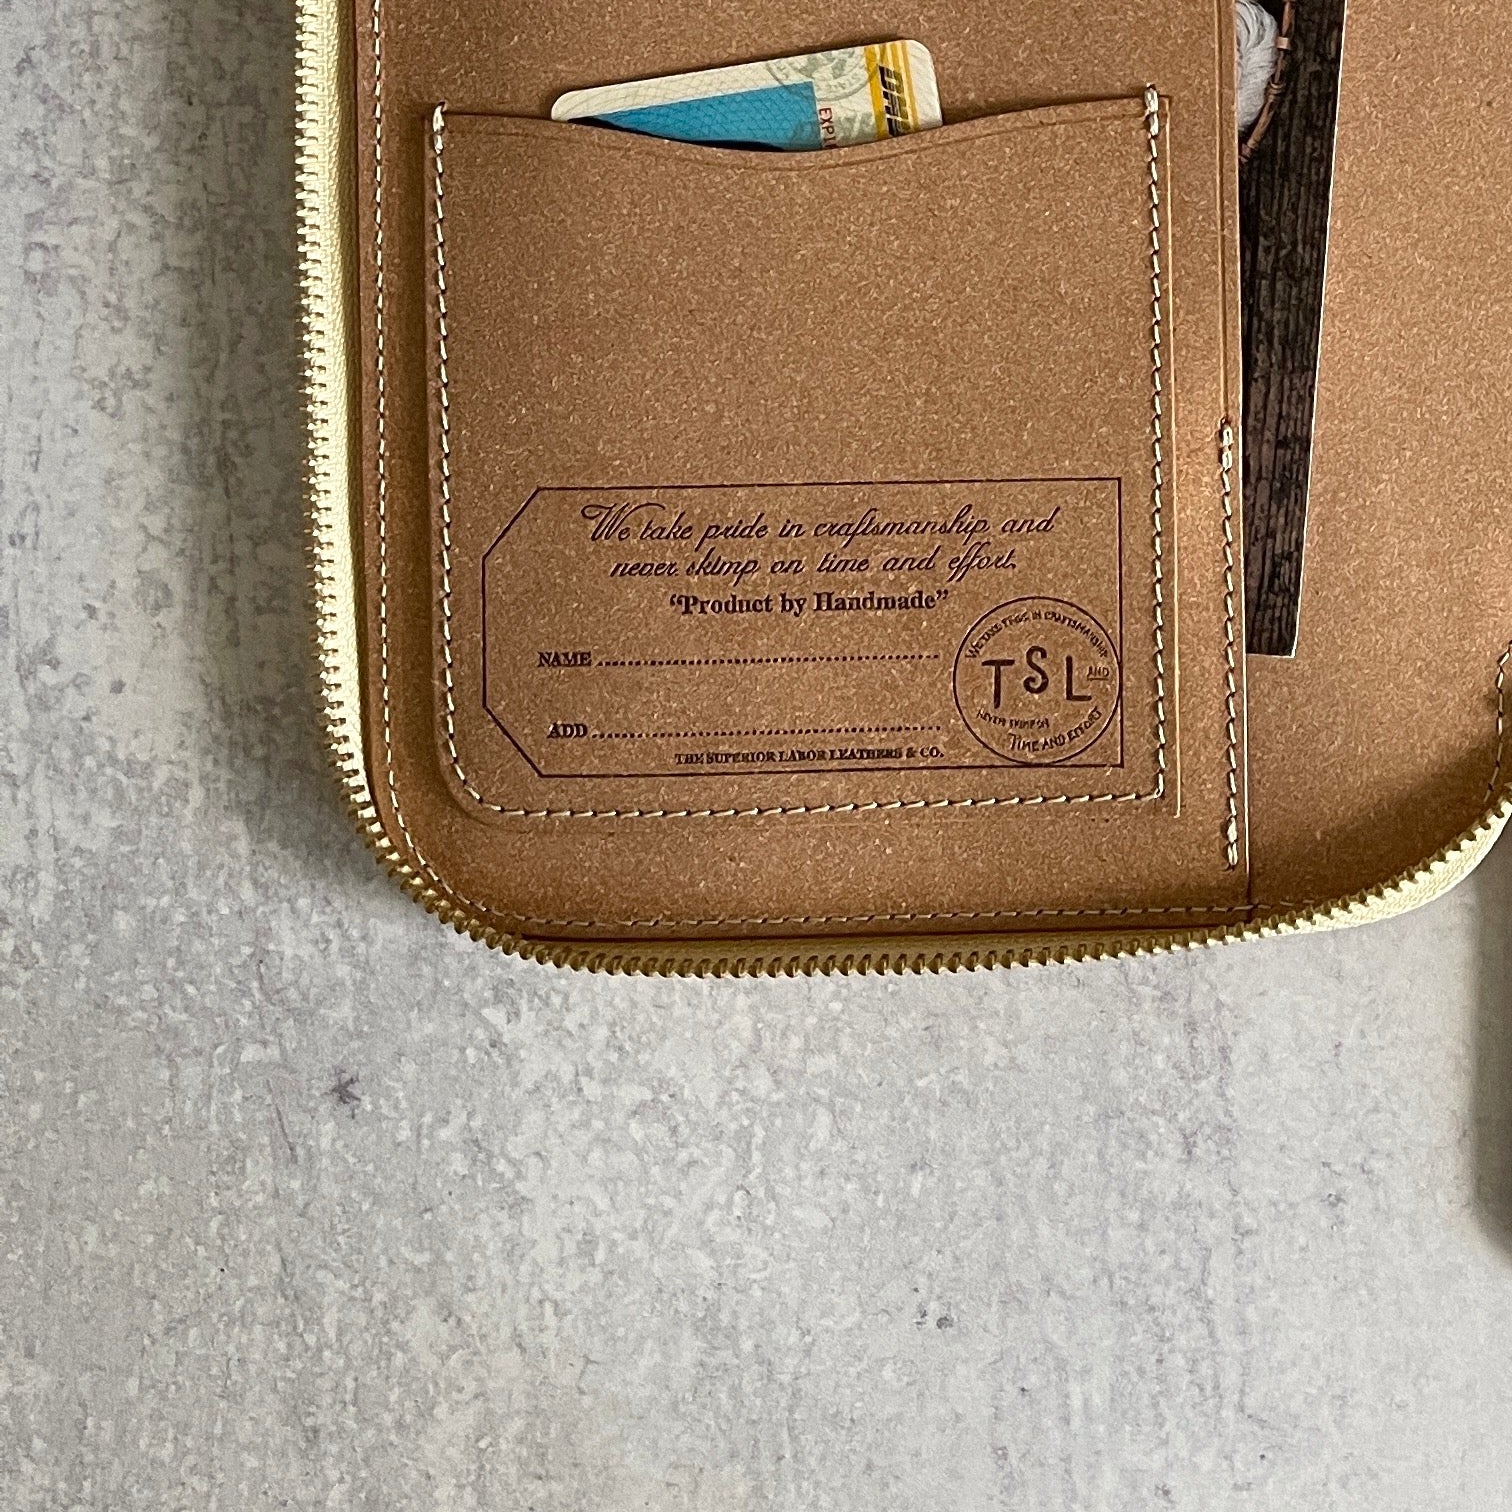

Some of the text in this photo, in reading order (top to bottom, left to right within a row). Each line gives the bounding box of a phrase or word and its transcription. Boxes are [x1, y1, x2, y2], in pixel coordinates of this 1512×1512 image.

[580, 502, 1061, 552] We take pride in craftsmanship and
[609, 560, 679, 577] never
[770, 559, 805, 574] on
[817, 552, 869, 573] time
[882, 545, 941, 571] and
[780, 592, 807, 617] by
[537, 651, 592, 668] NAME
[547, 722, 588, 738] ADD
[674, 752, 704, 765] THE
[706, 751, 775, 764] SUPERIOR
[778, 749, 826, 762] LABOR
[905, 748, 916, 758] &
[919, 746, 945, 758] CO.
